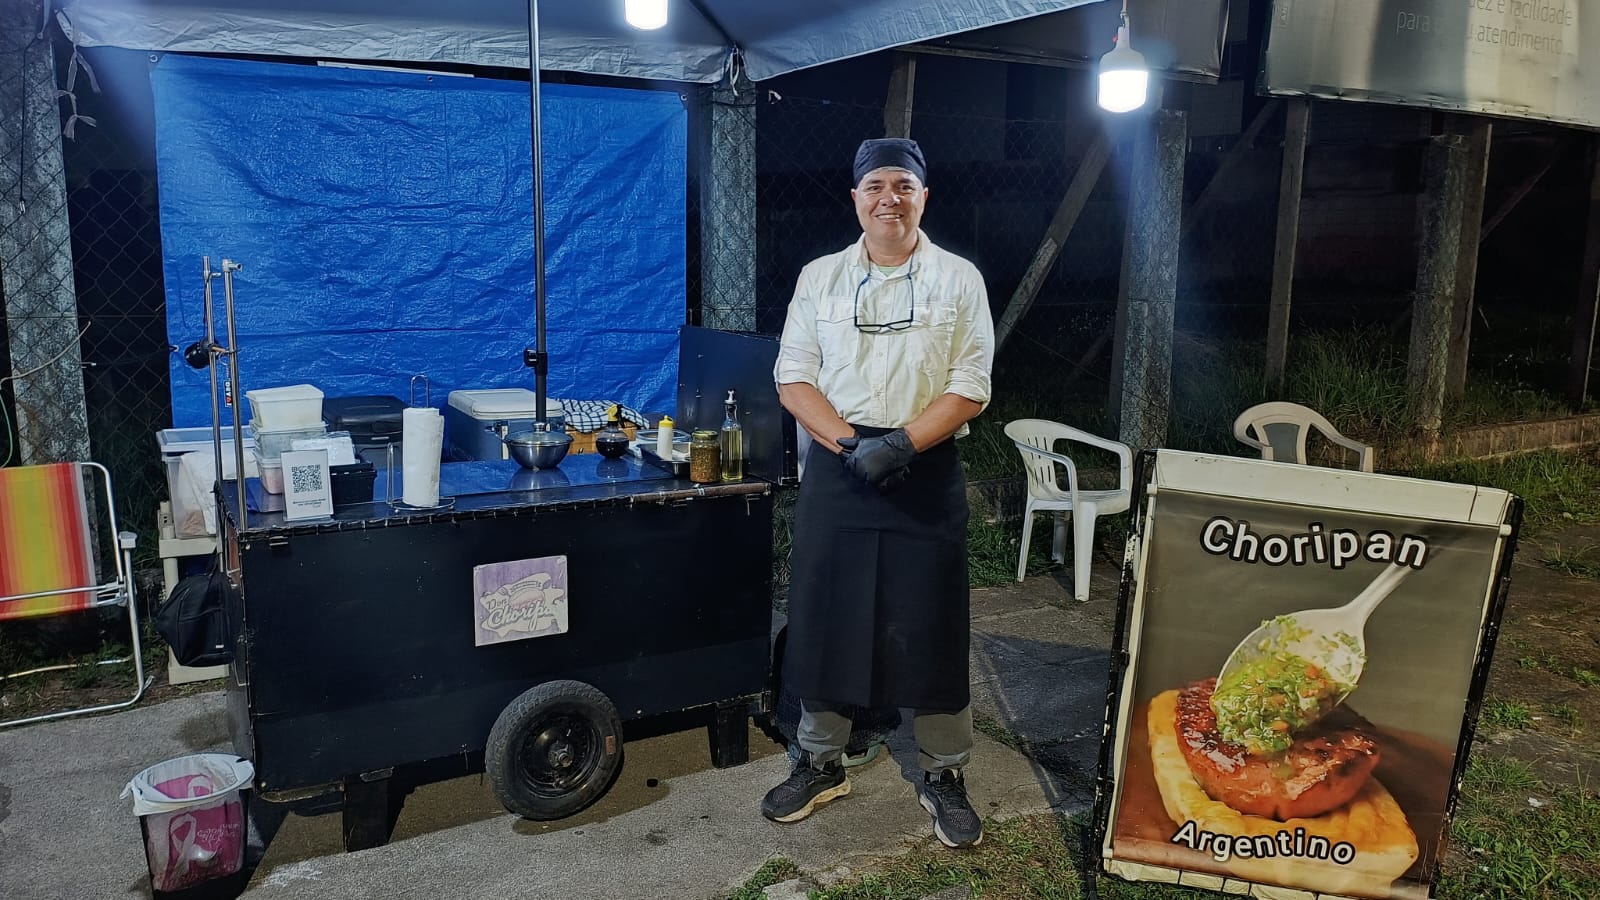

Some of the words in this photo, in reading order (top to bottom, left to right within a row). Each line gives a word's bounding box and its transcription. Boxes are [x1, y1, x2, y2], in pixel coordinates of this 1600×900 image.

[1396, 10, 1431, 36] para
[1201, 517, 1428, 568] Choripan
[1171, 820, 1355, 864] Argentino
